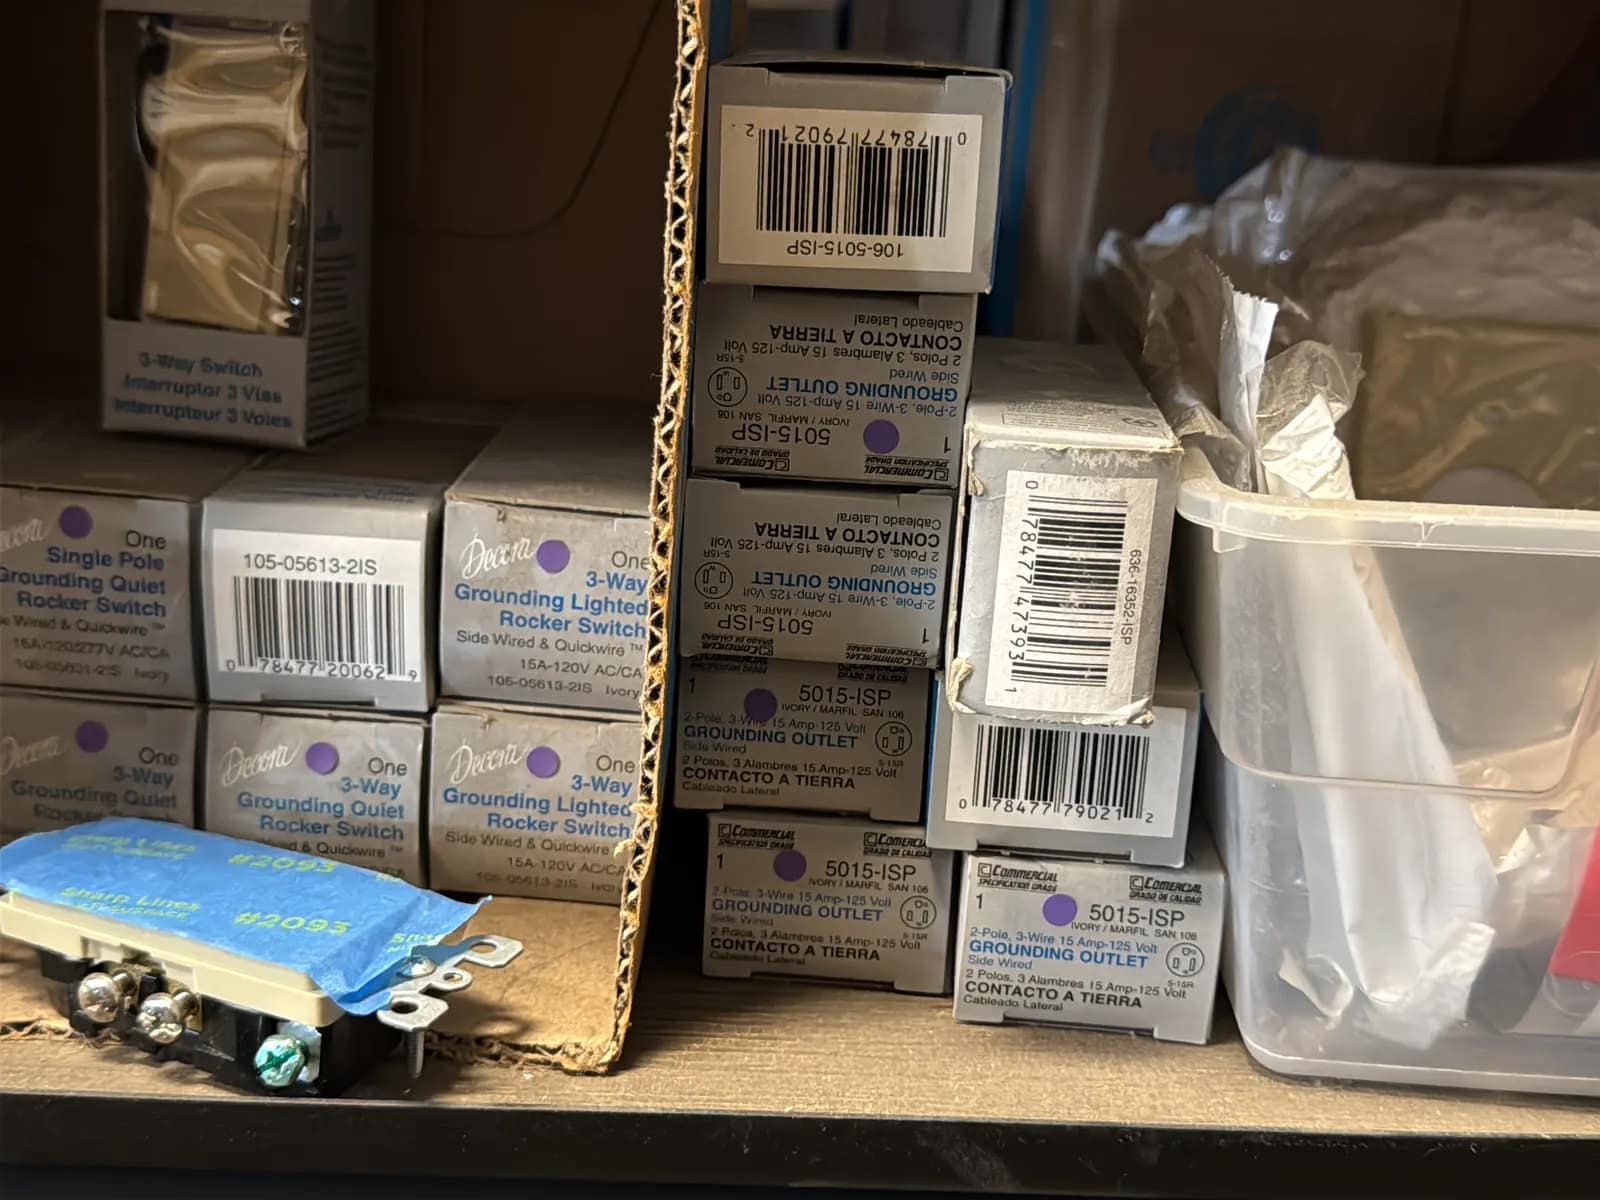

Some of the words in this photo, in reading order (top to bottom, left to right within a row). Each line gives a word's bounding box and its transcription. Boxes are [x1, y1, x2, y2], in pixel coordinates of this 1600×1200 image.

[782, 126, 847, 144] 79021
[861, 130, 929, 147] 78477
[787, 240, 904, 258] 106-5015-ISP
[854, 314, 897, 328] Lateral
[903, 319, 964, 332] Cableado
[769, 324, 836, 343] TIERRA
[844, 329, 854, 343] A
[861, 331, 962, 350] CONTACTO
[724, 339, 746, 353] Volt
[752, 343, 808, 357] Amp-125
[813, 348, 826, 358] 15
[833, 348, 892, 362] Alambres
[139, 352, 194, 375] 3-Way
[201, 358, 263, 377] Switch
[889, 368, 926, 381] Wired
[931, 371, 959, 384] Side
[125, 374, 221, 397] Interruptor
[228, 384, 237, 399] 3
[767, 376, 838, 394] OUTLET
[846, 381, 958, 401] GROUNDING
[758, 394, 780, 406] Volt
[786, 397, 843, 411] Amp-125
[846, 399, 860, 411] 15
[866, 402, 908, 414] 3-Wire
[115, 397, 222, 421] Interrupteur
[228, 408, 237, 423] 3
[243, 409, 292, 428] Voies
[739, 411, 762, 421] SAN
[768, 413, 808, 425] MARFIL
[733, 424, 830, 444] 5015-ISP
[837, 512, 878, 526] Lateral
[883, 516, 941, 530] Cableado
[126, 530, 167, 549] One
[755, 522, 818, 539] TIERRA
[826, 527, 837, 540] A
[843, 528, 940, 547] CONTACTO
[711, 537, 732, 549] Volt
[738, 539, 793, 554] Amp-125
[797, 543, 809, 554] 15
[817, 544, 873, 558] Alambres
[1016, 518, 1038, 585] 78477
[48, 547, 112, 570] Single
[119, 551, 164, 571] Pole
[243, 553, 377, 575] 105-05613-2IS
[612, 550, 649, 570] One
[752, 571, 821, 588] OUTLET
[871, 564, 906, 577] Wired
[911, 567, 937, 579] Side
[111, 575, 166, 595] Quiet
[586, 571, 648, 595] 3-Way
[828, 576, 936, 596] GROUNDING
[455, 583, 564, 611] Grounding
[572, 594, 648, 616] Lighted
[744, 588, 765, 600] Volt
[770, 591, 825, 605] Amp-125
[828, 594, 842, 605] 15
[848, 596, 888, 607] 3-Wire
[1121, 548, 1141, 645] 636-16352-ISP
[17, 591, 89, 610] Rocker
[96, 597, 167, 617] Switch
[725, 604, 747, 614] SAN
[754, 606, 792, 617] MARFIL
[500, 610, 571, 631] Rocker
[578, 617, 647, 638] Switch
[718, 614, 813, 635] 5015-ISP
[1009, 595, 1030, 661] 47393
[457, 630, 489, 644] Side
[493, 633, 535, 649] Wired
[555, 639, 625, 656] Quickwire
[261, 659, 316, 675] 78477
[328, 663, 384, 679] 20062
[521, 658, 590, 674] 15A-120V
[595, 665, 642, 678] AC/CA
[606, 686, 640, 699] Ivory
[799, 685, 891, 707] 5015-ISP
[819, 705, 856, 716] MARFIL
[864, 708, 883, 718] SAN
[684, 726, 786, 743] GROUNDING
[792, 731, 858, 748] OUTLET
[139, 747, 180, 766] One
[713, 743, 746, 754] Wired
[368, 757, 408, 776] One
[596, 755, 635, 773] One
[743, 760, 798, 771] Alambres
[803, 763, 816, 773] 15
[820, 765, 871, 777] Amp-125
[876, 767, 897, 778] Volt
[114, 766, 174, 787] 3-Way
[683, 767, 774, 784] CONTACTO
[779, 772, 790, 785] A
[796, 774, 856, 789] TIERRA
[12, 780, 118, 807] Grounding
[341, 777, 401, 800] 3-Way
[571, 775, 633, 798] 3-Way
[741, 785, 780, 796] Lateral
[238, 792, 345, 819] Grounding
[352, 801, 404, 819] Quiet
[443, 788, 550, 815] Grounding
[993, 798, 1051, 815] 78477
[1063, 804, 1123, 821] 79021
[260, 815, 329, 834] Rocker
[337, 821, 404, 841] Switch
[488, 814, 558, 832] Rocker
[564, 819, 631, 838] Switch
[317, 842, 385, 857] Quickwire
[446, 831, 477, 845] Side
[481, 834, 522, 848] Wired
[541, 839, 609, 855] Quickwire
[229, 853, 339, 874] #2093
[825, 861, 916, 881] 5015-ISP
[888, 883, 908, 893] SAN
[712, 899, 812, 917] GROUNDING
[818, 904, 883, 921] OUTLET
[1089, 904, 1185, 928] 5015-ISP
[234, 912, 354, 935] #2093
[1071, 922, 1101, 932] IVORY
[1109, 924, 1148, 937] MARFIL
[1155, 928, 1176, 940] SAN
[711, 938, 800, 956] CONTACTO
[806, 944, 816, 956] A
[822, 946, 880, 961] TIERRA
[829, 935, 841, 945] 15
[1016, 931, 1054, 943] 3-Wire
[1061, 934, 1073, 945] 15
[1077, 935, 1131, 951] Amp-125
[1136, 941, 1158, 954] Volt
[968, 954, 994, 967] Side
[998, 958, 1033, 970] Wired
[969, 940, 1074, 961] GROUNDING
[1080, 950, 1148, 969] OUTLET
[965, 980, 1058, 1000] CONTACTO
[1064, 990, 1074, 1002] A
[1081, 991, 1142, 1008] TIERRA
[1029, 974, 1084, 989] Alambres
[1090, 981, 1102, 991] 15
[1106, 982, 1160, 996] Amp-125
[1164, 988, 1186, 999] Volt
[964, 994, 1019, 1008] Cableado
[1023, 999, 1063, 1011] Lateral
